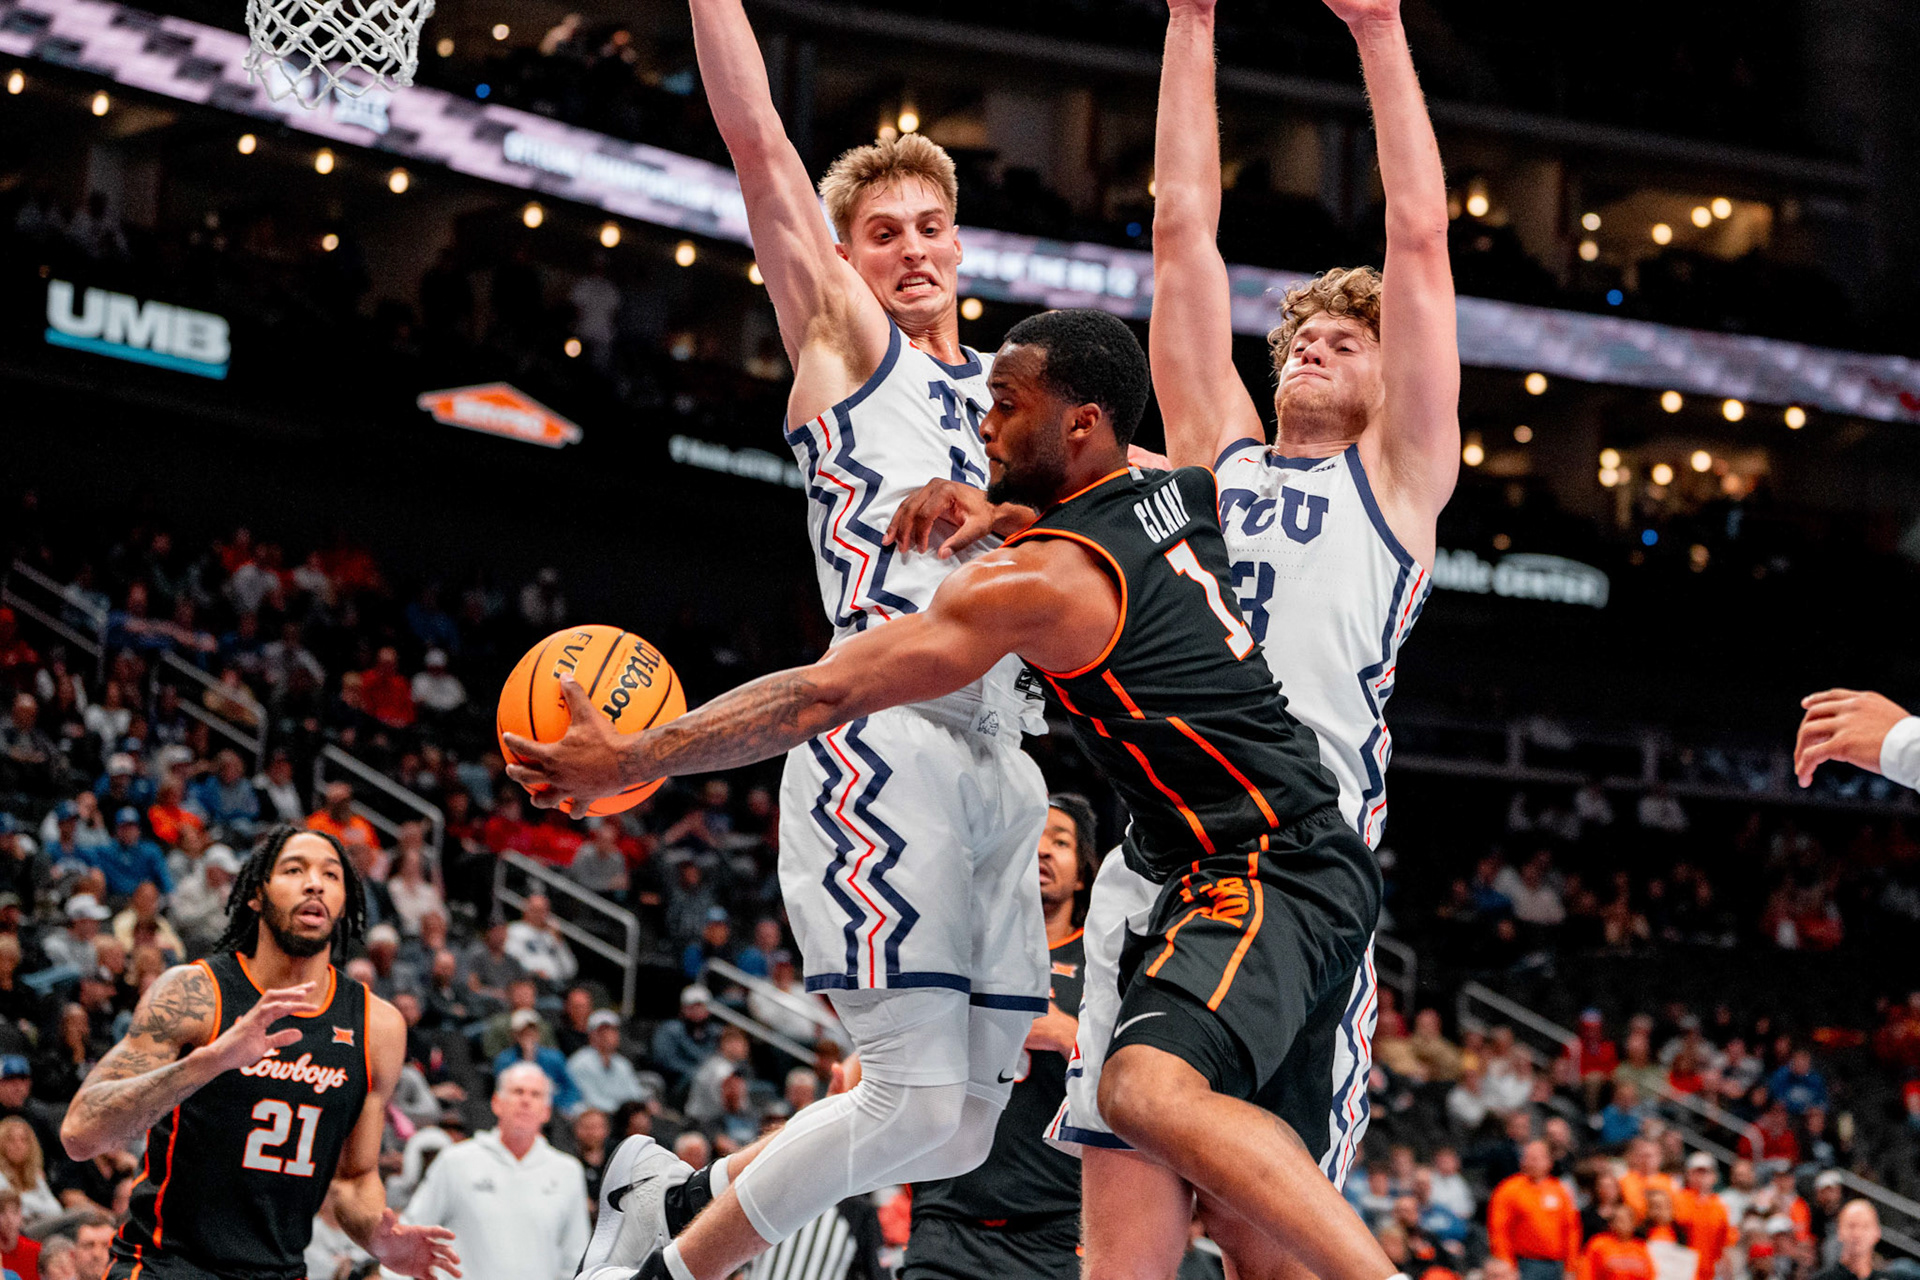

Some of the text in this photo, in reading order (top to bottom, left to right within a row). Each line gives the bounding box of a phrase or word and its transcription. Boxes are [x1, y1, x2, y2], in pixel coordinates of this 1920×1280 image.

[47, 279, 231, 365] UMB
[1133, 478, 1191, 543] CLARY
[1219, 485, 1329, 545] TCU
[1164, 538, 1255, 661] 1
[1231, 561, 1276, 645] 3
[242, 1098, 323, 1177] 21
